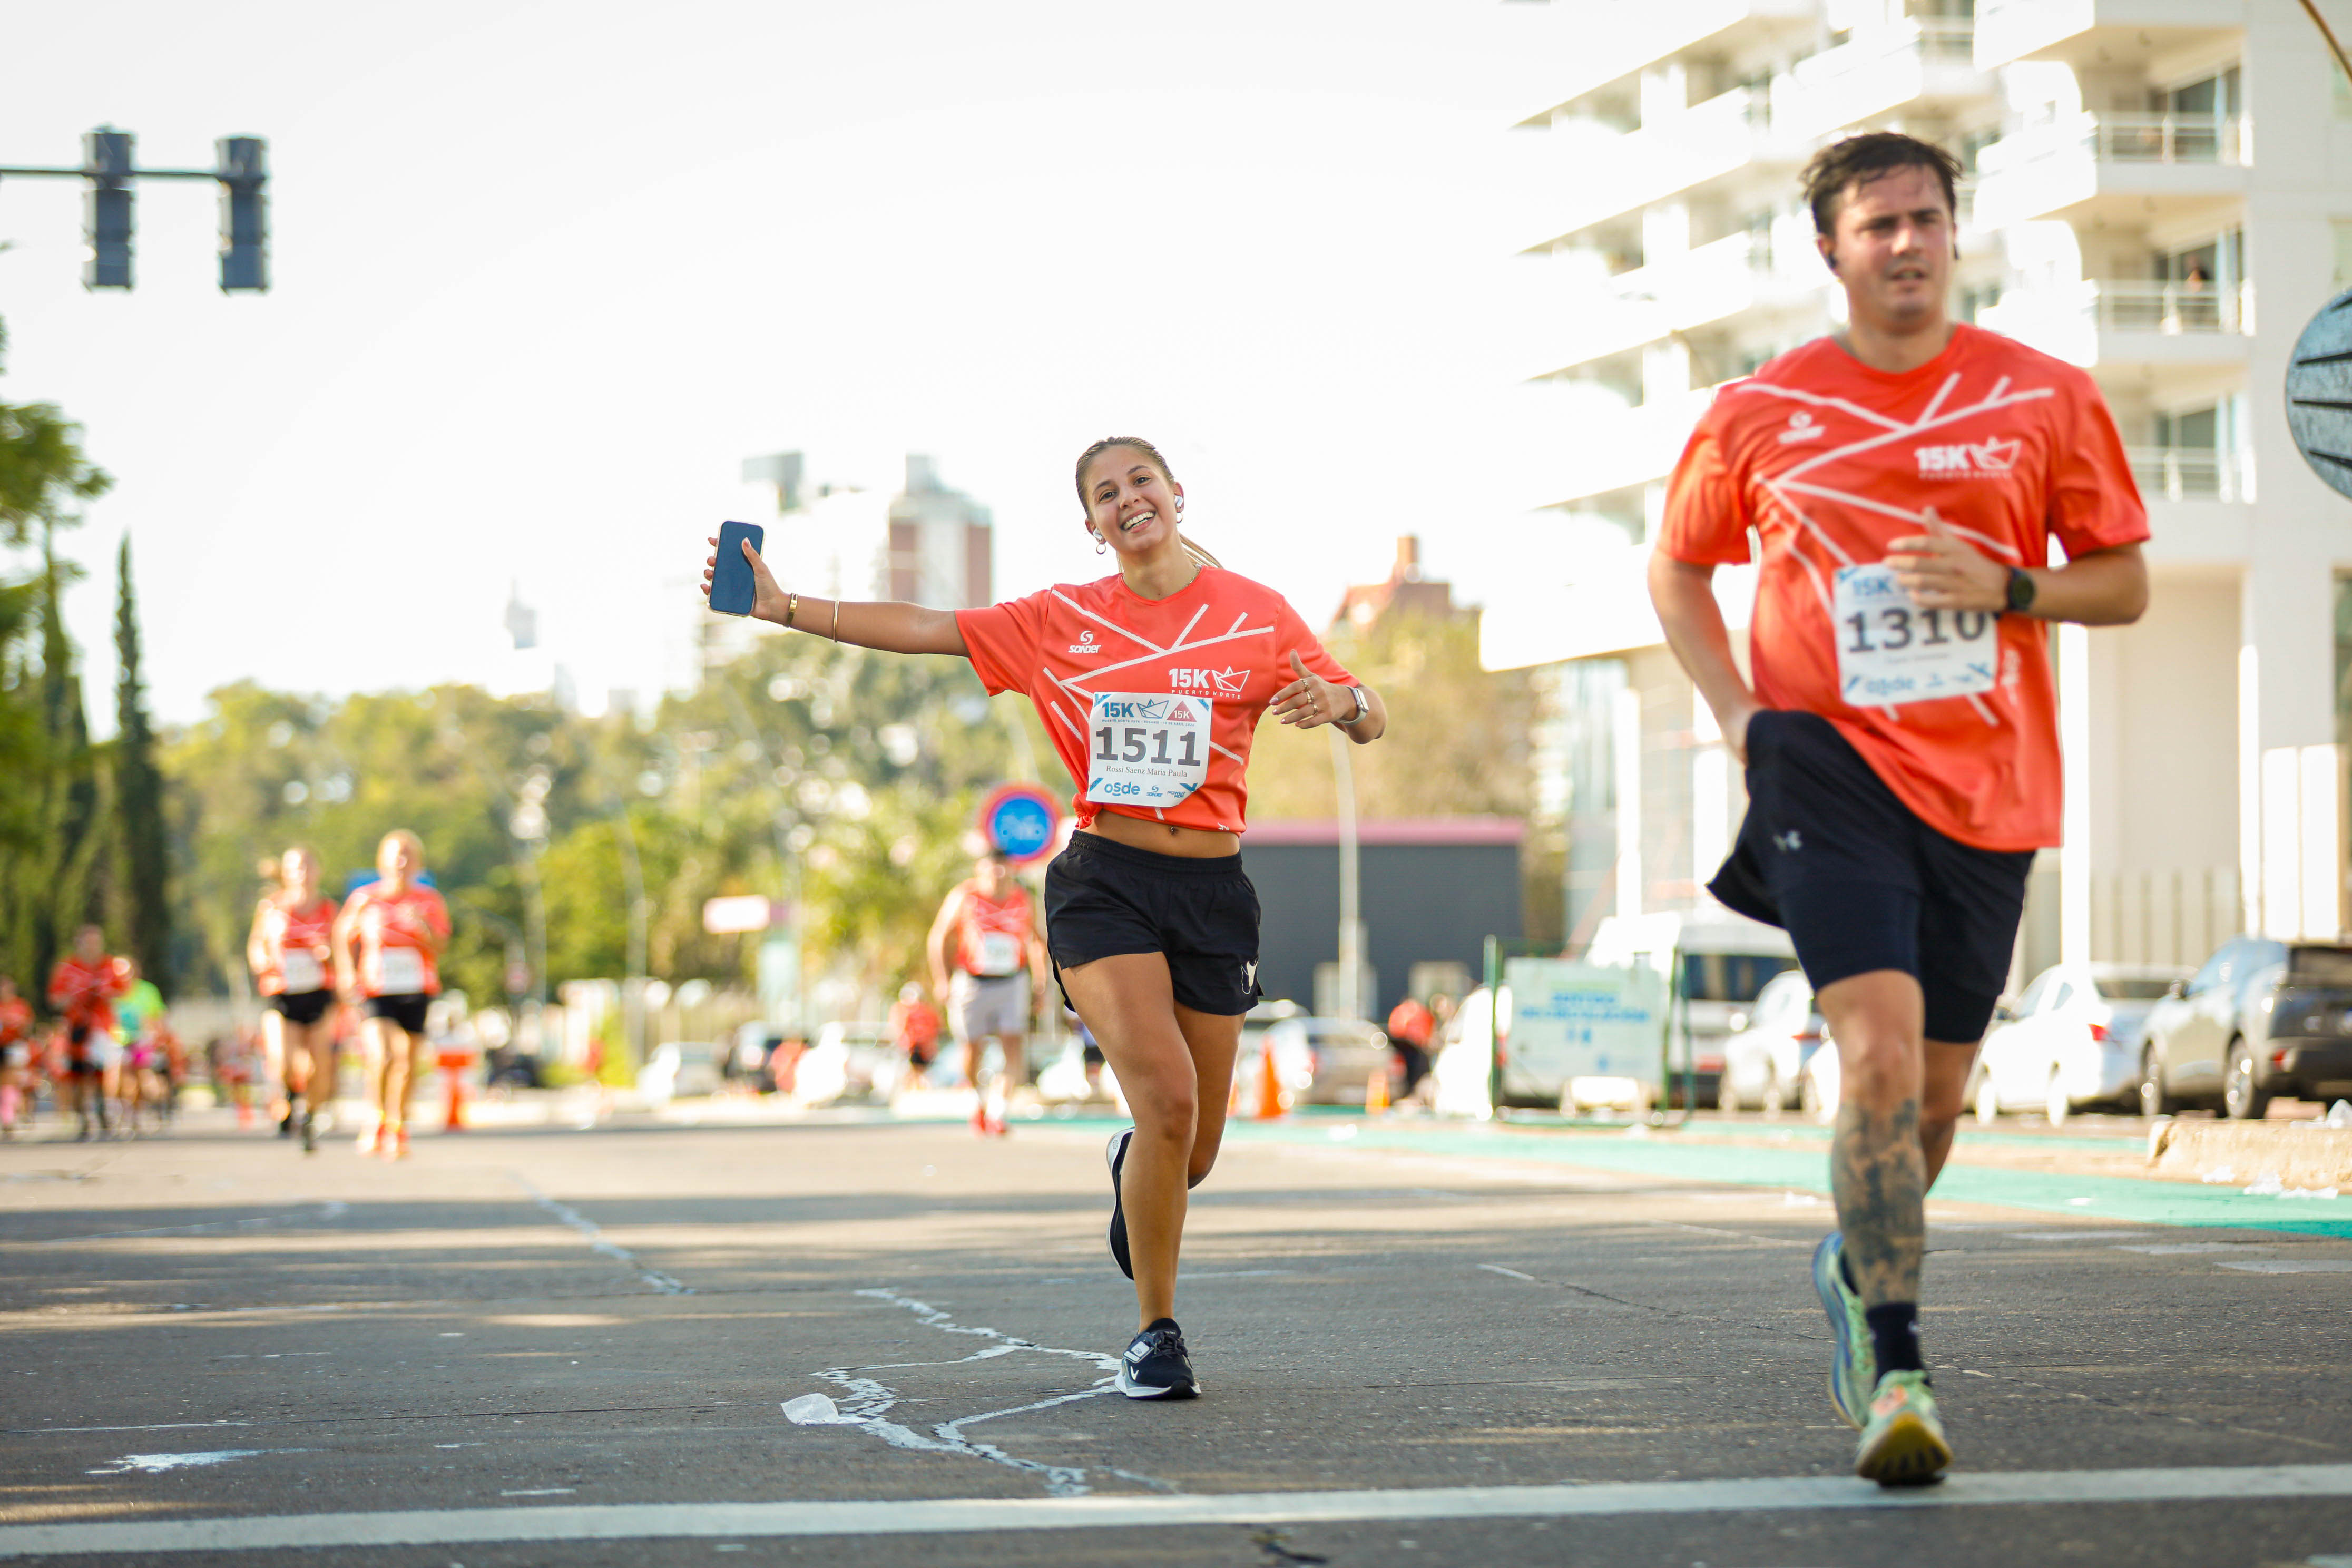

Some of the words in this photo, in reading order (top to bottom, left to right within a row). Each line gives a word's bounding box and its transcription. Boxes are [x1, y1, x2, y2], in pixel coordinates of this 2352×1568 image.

[1914, 444, 1971, 469] 15K
[1846, 606, 1987, 653] 1310
[1169, 668, 1210, 688] 15K
[1102, 702, 1134, 718] 15K
[1174, 710, 1190, 719] 15K
[1096, 727, 1201, 766] 1511
[1104, 781, 1140, 796] osde
